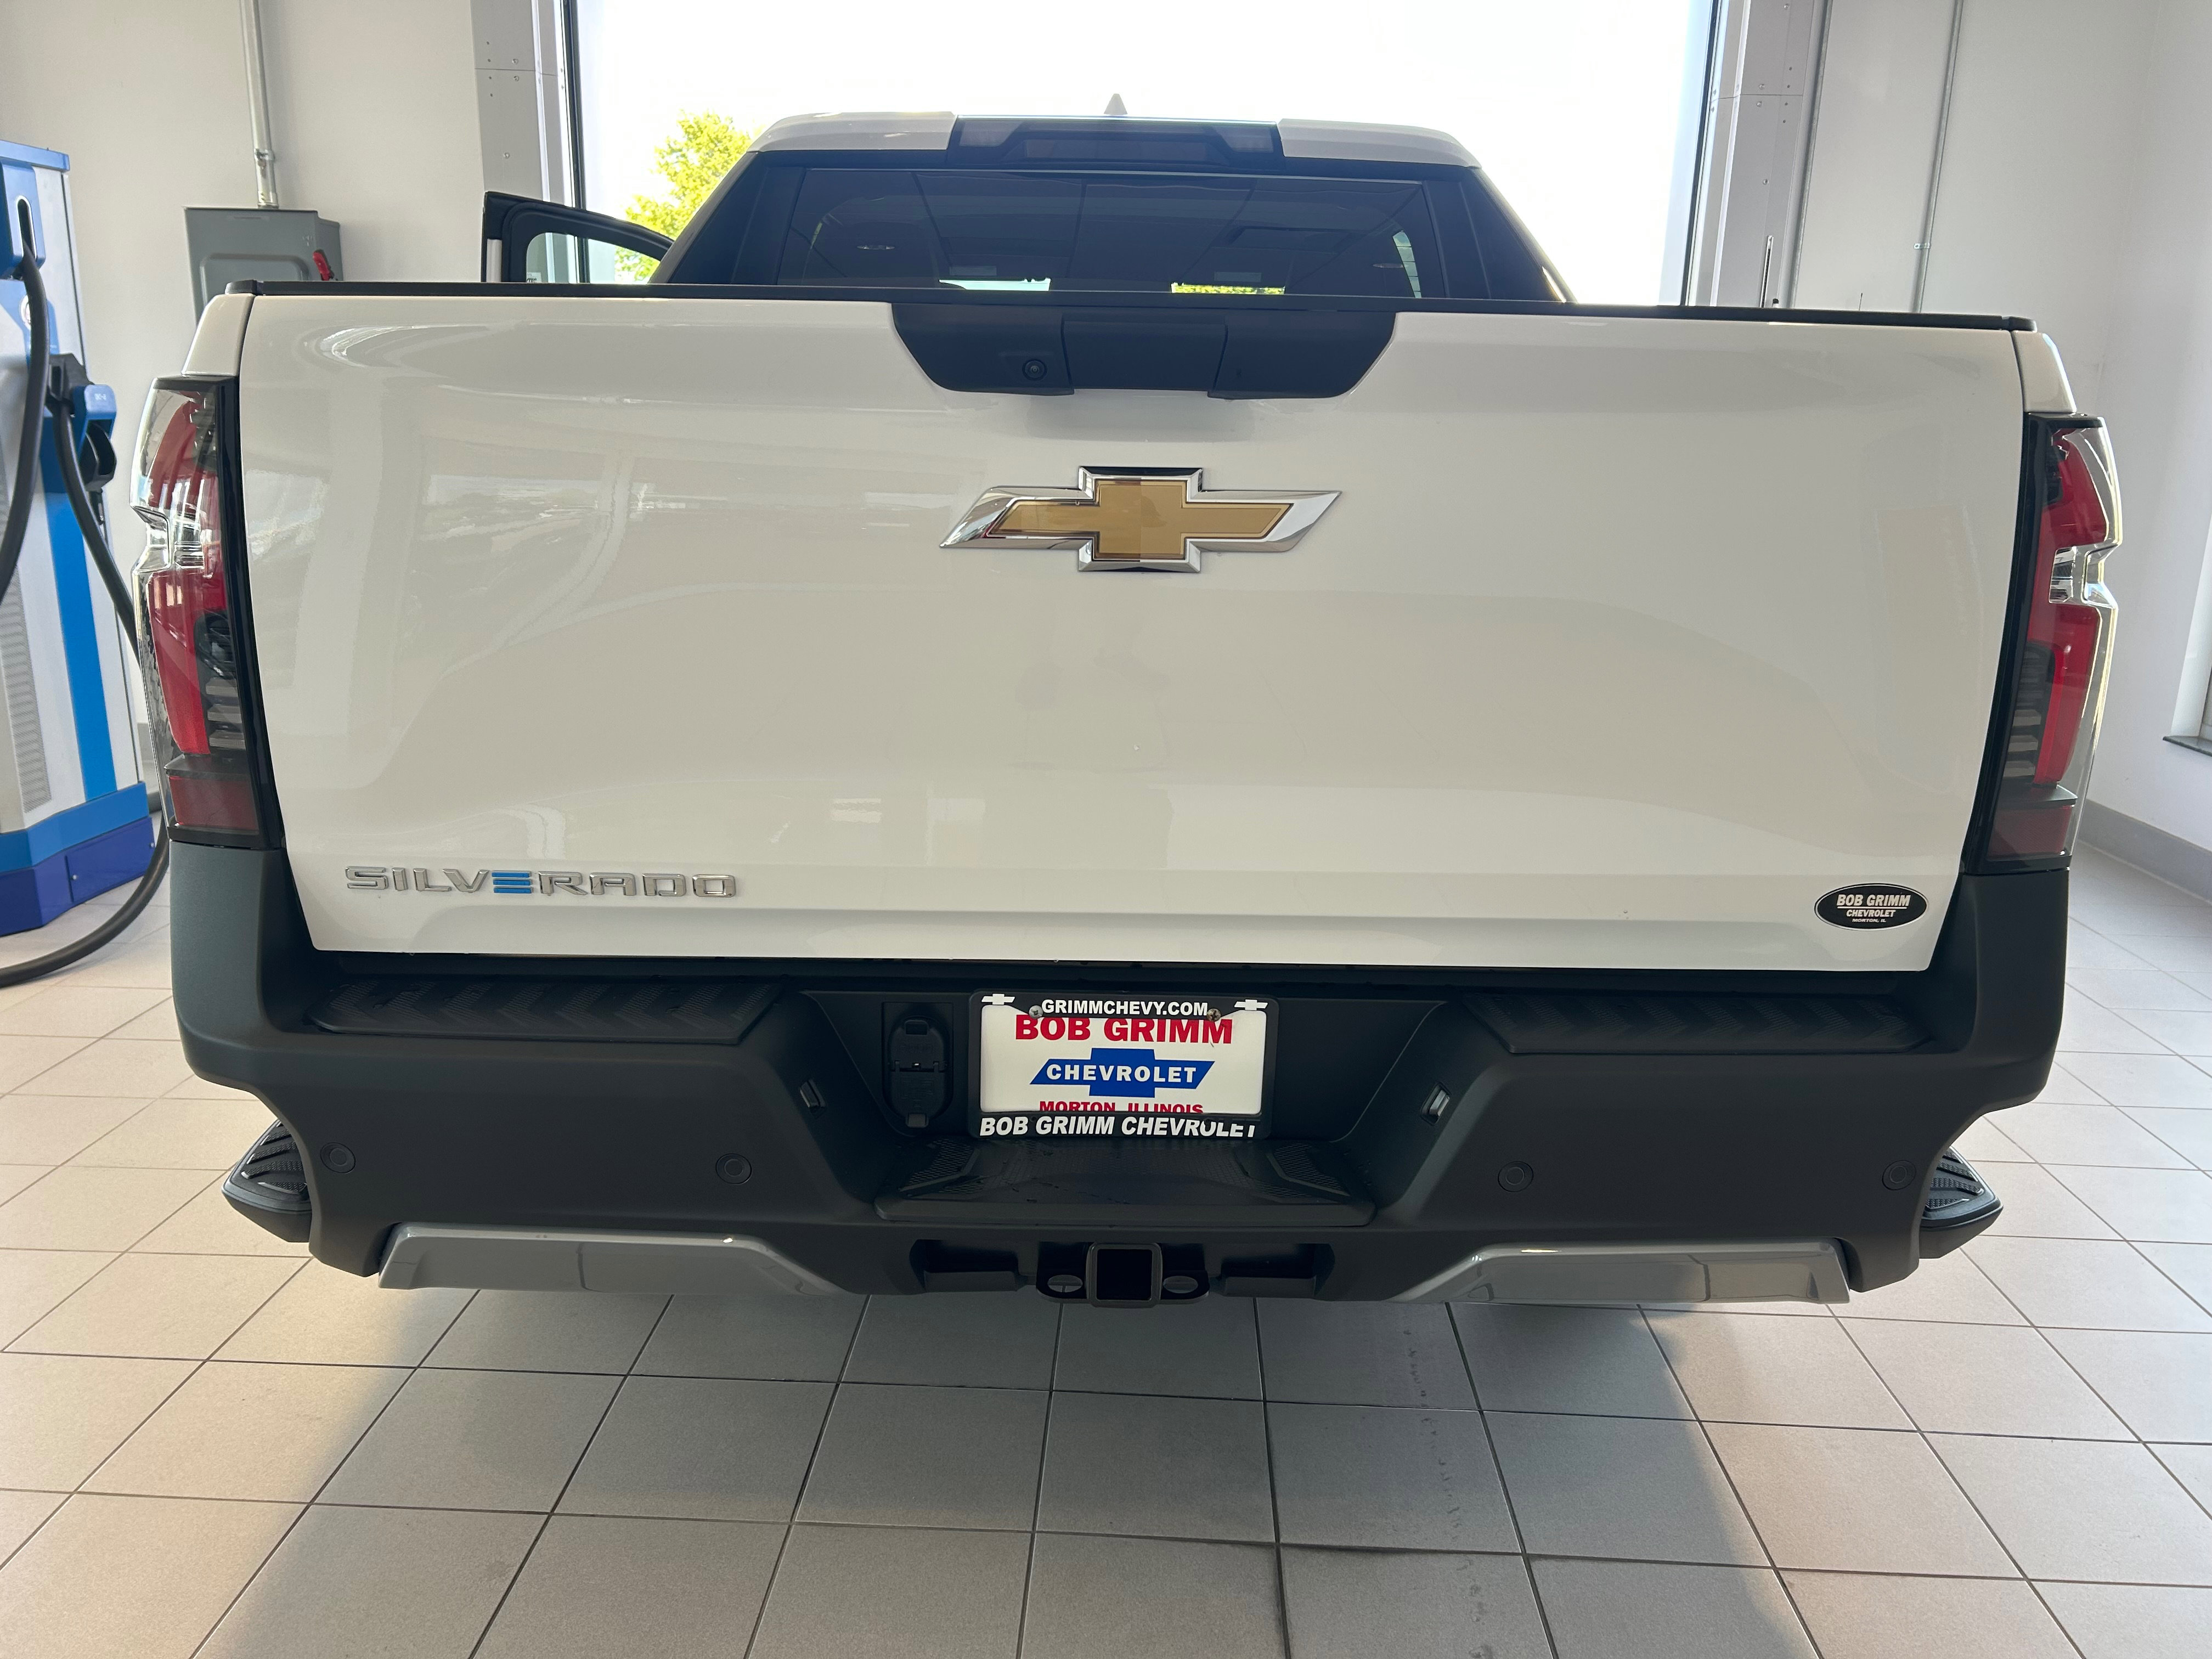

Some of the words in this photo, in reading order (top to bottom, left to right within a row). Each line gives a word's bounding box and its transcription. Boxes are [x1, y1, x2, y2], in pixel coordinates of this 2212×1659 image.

[346, 866, 736, 898] SILVERADO
[1837, 894, 1864, 906] BOB
[1866, 895, 1911, 906] GRIMM
[1042, 1000, 1207, 1016] GRIMMCHEVY.COM
[1015, 1015, 1091, 1040] BOB
[1104, 1018, 1233, 1043] GRIMM
[1046, 1064, 1196, 1082] CHEVROLET
[980, 1117, 1029, 1136] BOB
[1036, 1116, 1115, 1135] GRIMM
